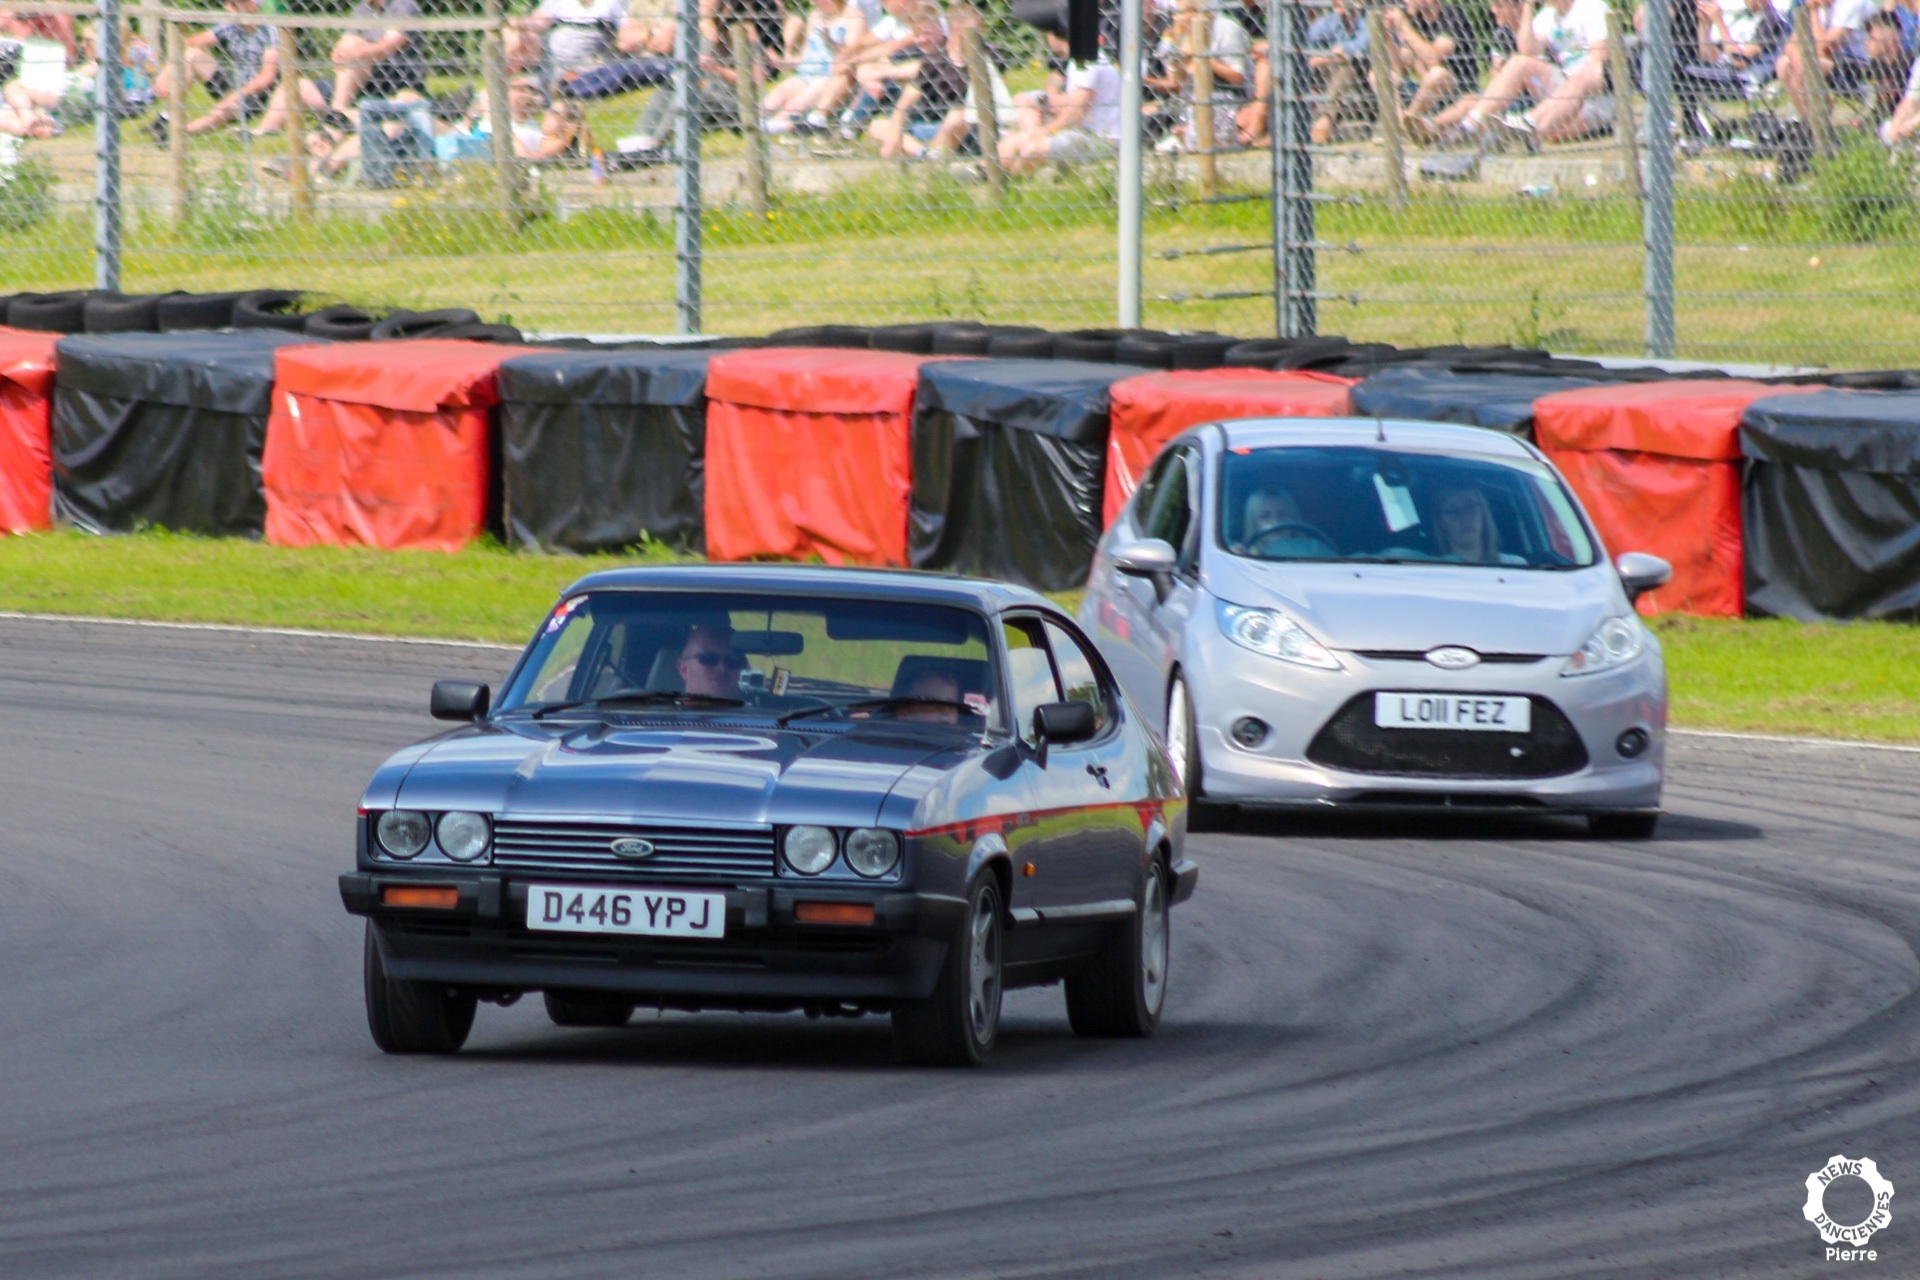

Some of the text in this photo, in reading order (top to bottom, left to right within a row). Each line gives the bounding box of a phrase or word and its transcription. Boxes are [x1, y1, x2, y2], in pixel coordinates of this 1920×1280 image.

[1456, 700, 1506, 725] FEZ
[542, 891, 710, 930] D446 YPJ
